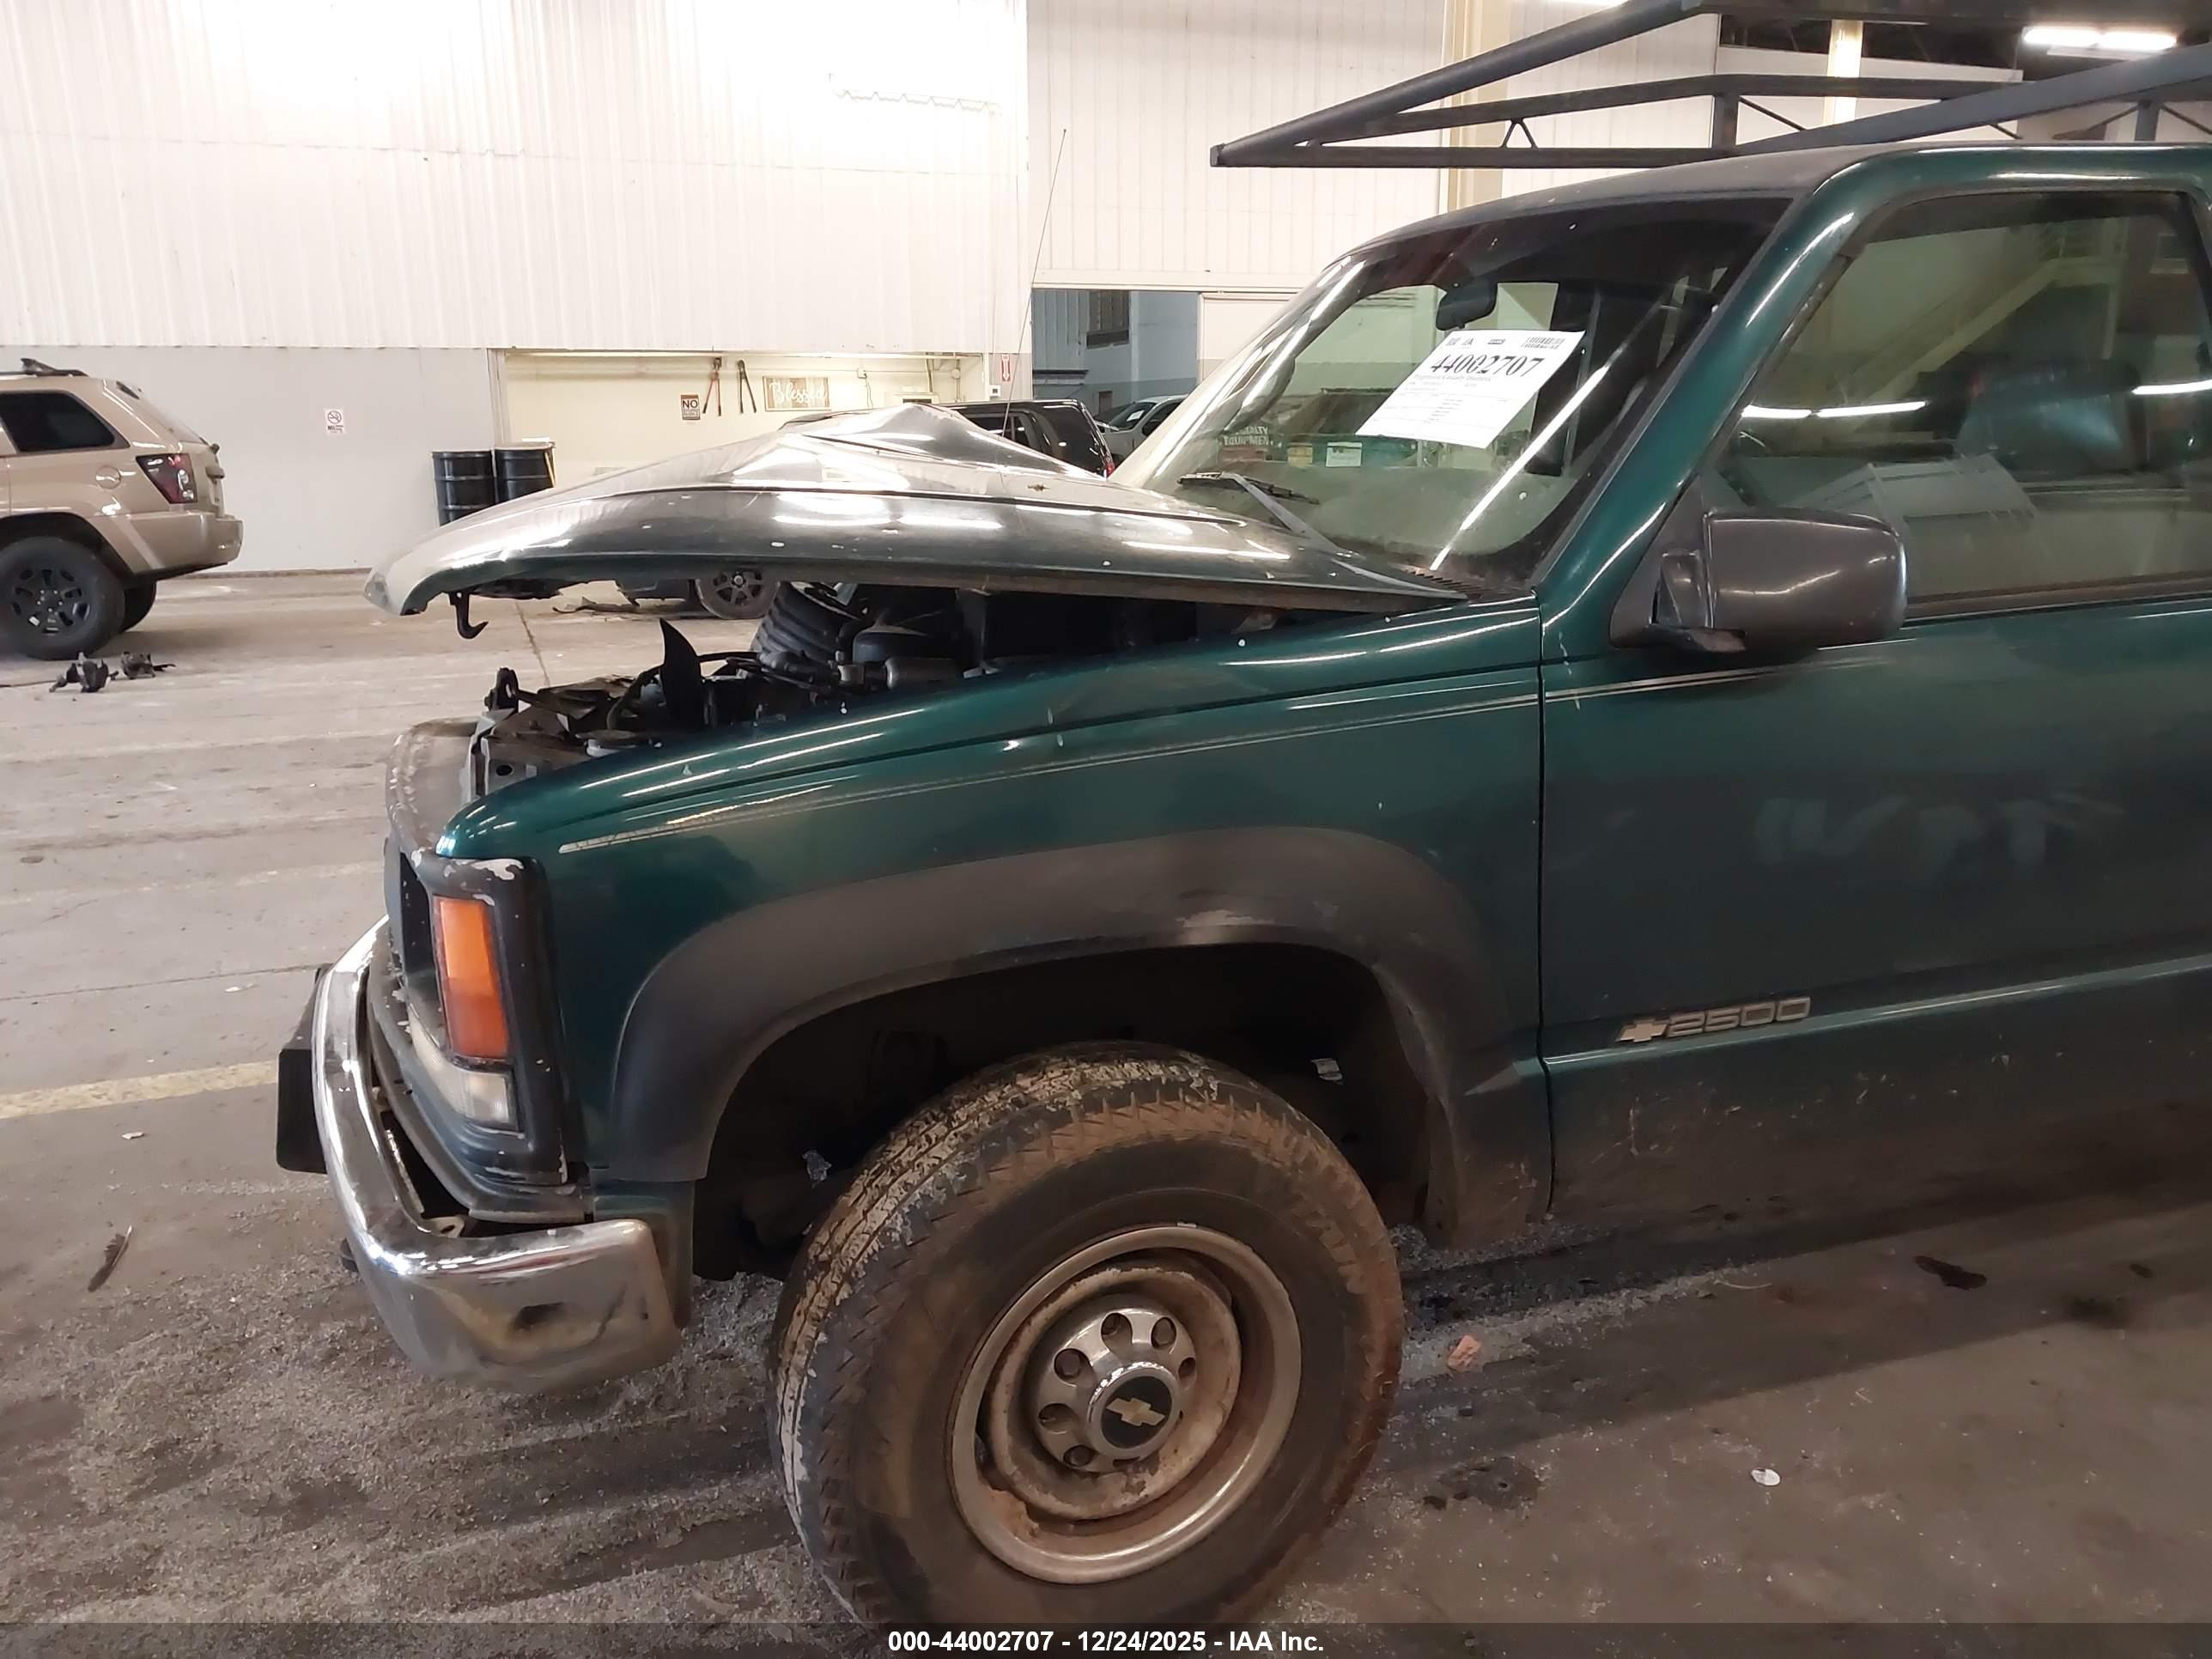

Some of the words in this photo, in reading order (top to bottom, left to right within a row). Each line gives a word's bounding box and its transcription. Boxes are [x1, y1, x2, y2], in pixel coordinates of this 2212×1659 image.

[1430, 353, 1546, 377] 44002707
[682, 399, 698, 409] NO
[769, 382, 828, 407] Blessed
[1667, 995, 1812, 1037] 2500
